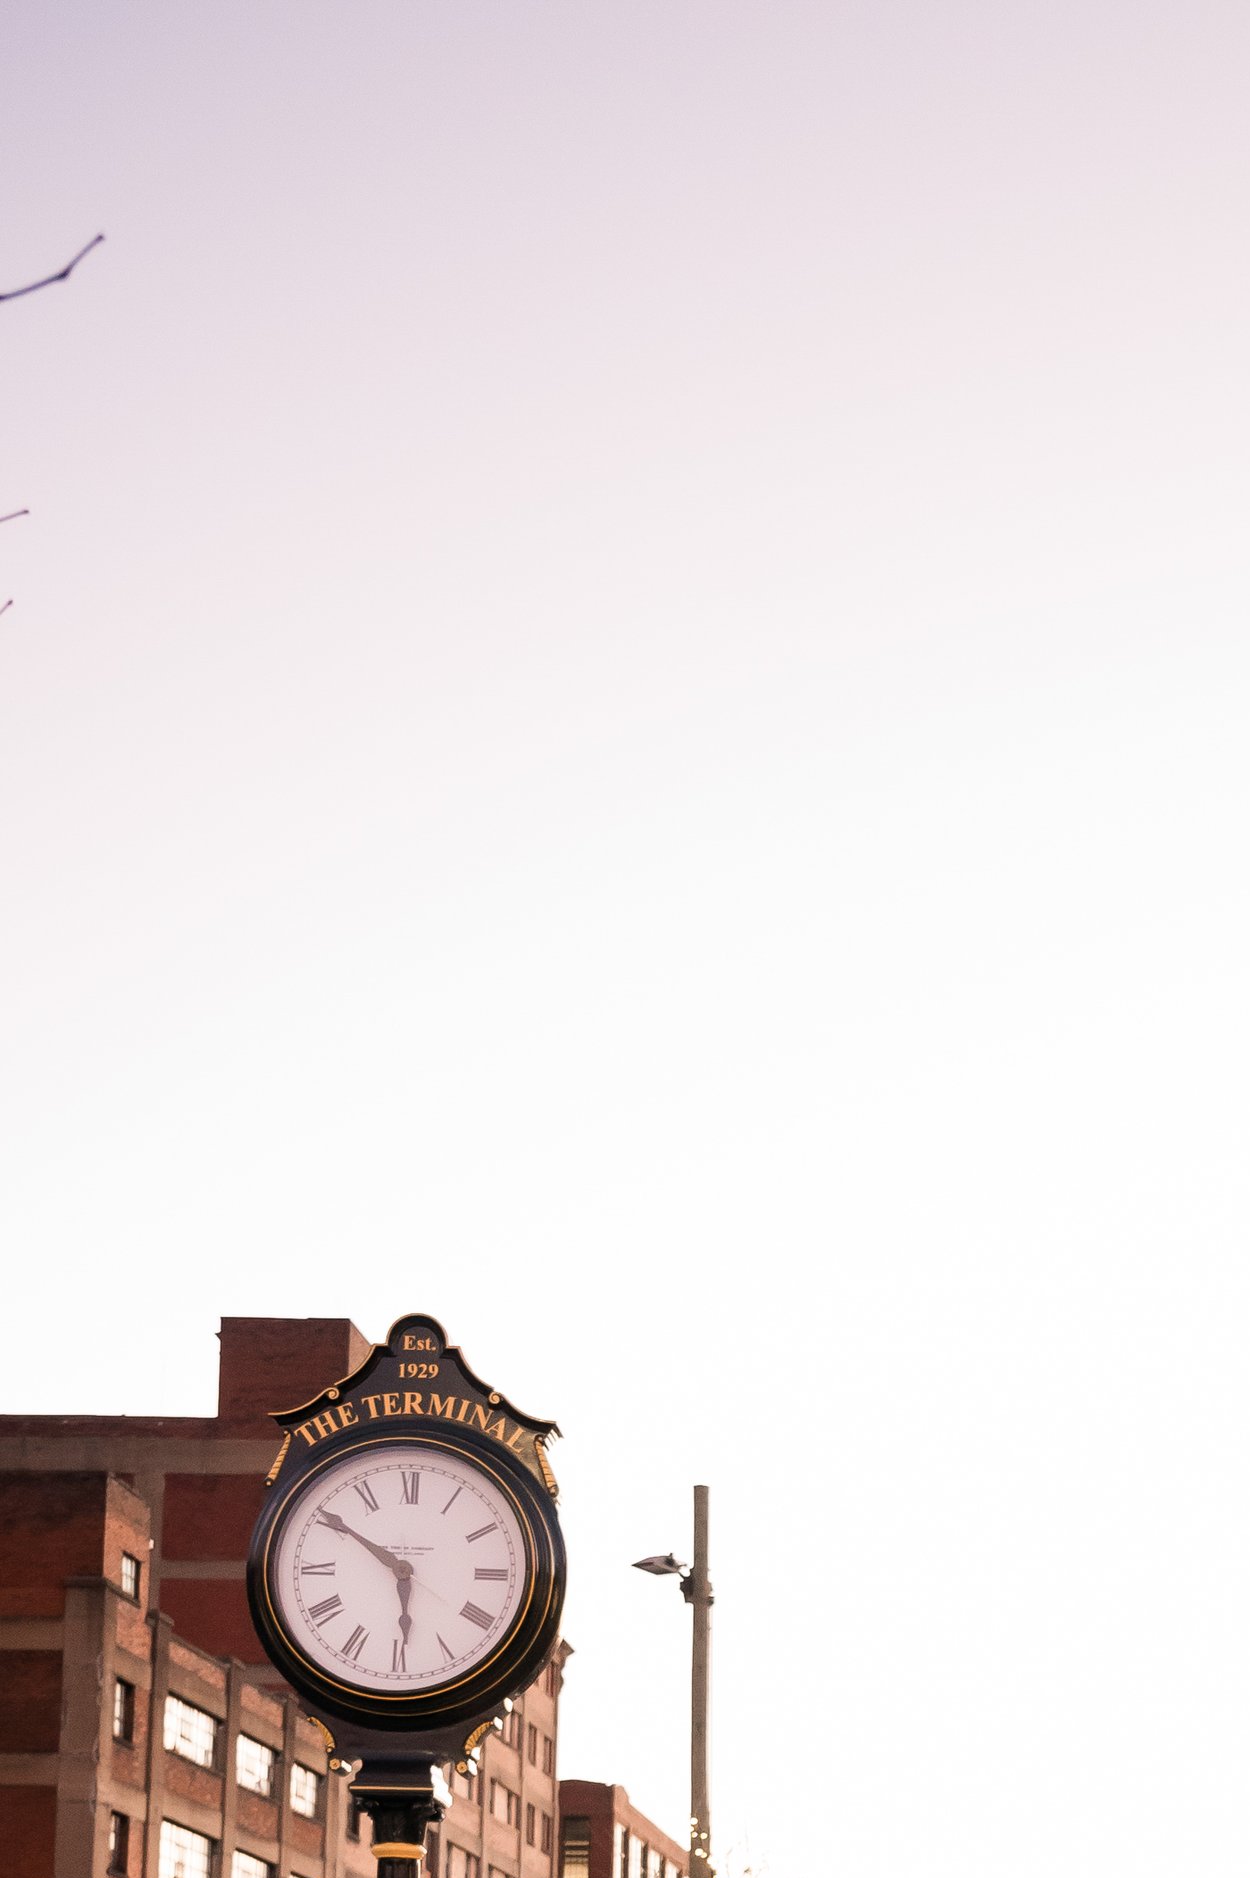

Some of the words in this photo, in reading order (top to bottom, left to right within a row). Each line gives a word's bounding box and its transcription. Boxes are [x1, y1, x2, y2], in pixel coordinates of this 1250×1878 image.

[403, 1334, 437, 1351] Est.
[399, 1363, 439, 1379] 1929
[294, 1402, 360, 1447] THE
[361, 1391, 528, 1453] TERMINAL
[353, 1480, 380, 1517] XI
[400, 1471, 421, 1505] XII
[474, 1568, 509, 1581] III
